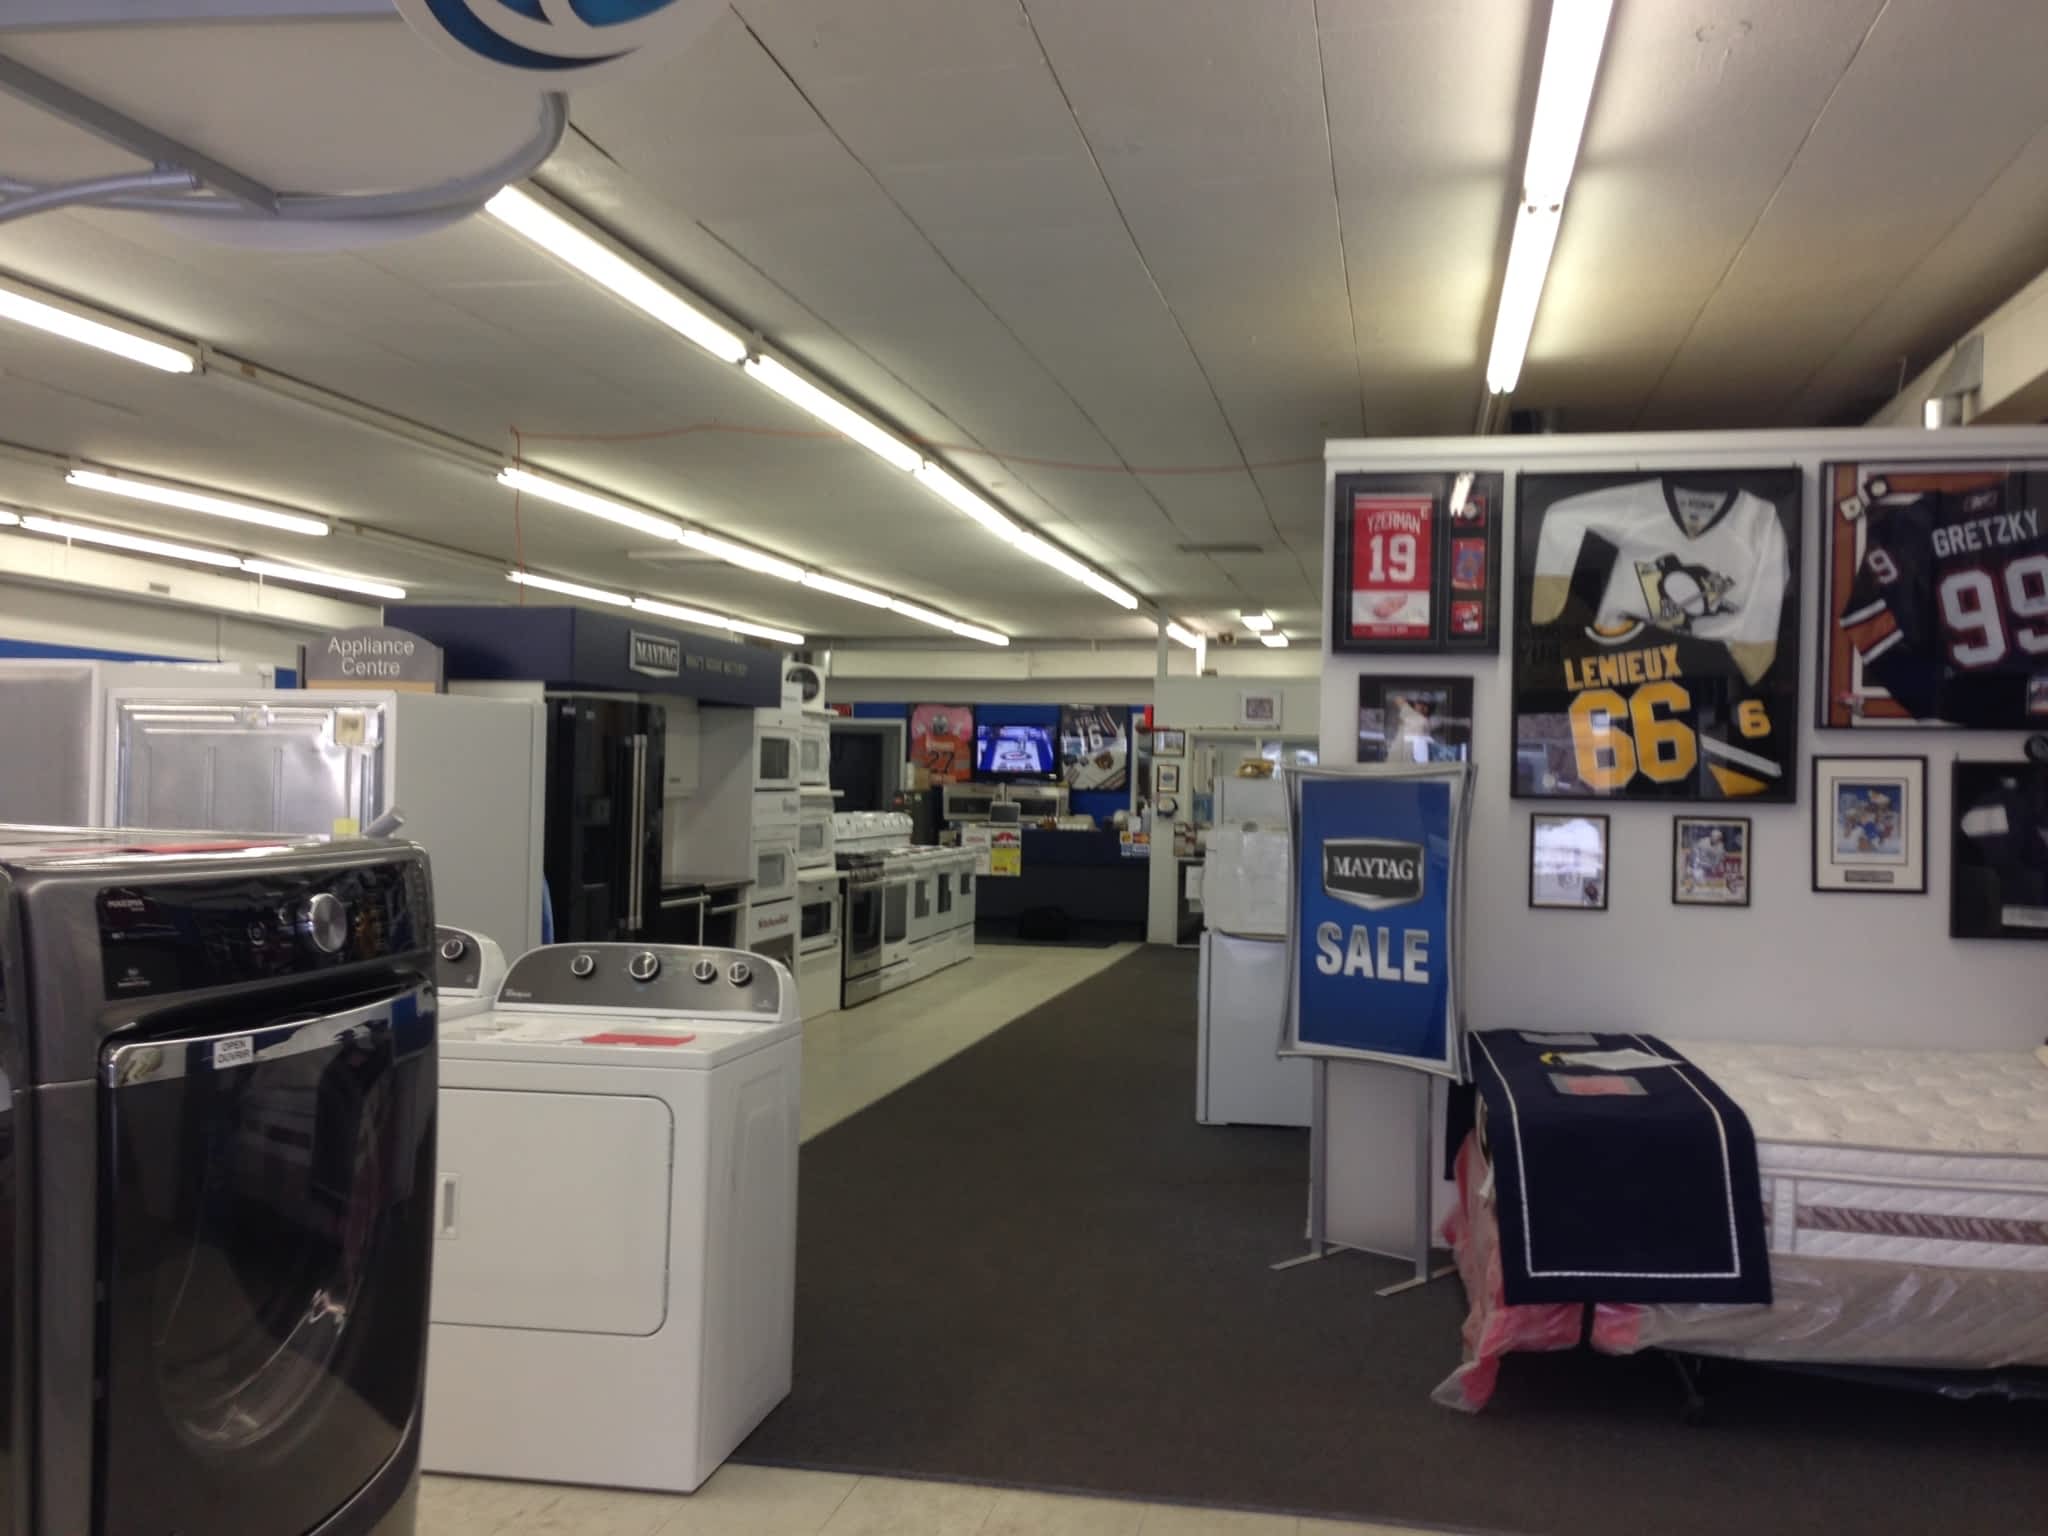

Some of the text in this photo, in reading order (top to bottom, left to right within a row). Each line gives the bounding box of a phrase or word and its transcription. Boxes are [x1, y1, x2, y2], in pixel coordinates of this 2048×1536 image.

[1367, 510, 1421, 535] YZERMAN
[1931, 508, 2040, 559] GRETZKY
[1368, 533, 1416, 583] 19
[1867, 546, 1898, 584] 9
[1939, 554, 2048, 668] 99
[327, 636, 415, 658] Appliance
[636, 640, 678, 667] MAYTAG
[341, 657, 401, 676] Centre
[1563, 644, 1683, 692] LEMIEUX
[1568, 680, 1698, 792] 66
[1738, 699, 1772, 738] 6
[1332, 856, 1414, 881] MAYTAG
[1316, 921, 1430, 985] SALE
[222, 1040, 247, 1052] OPEN
